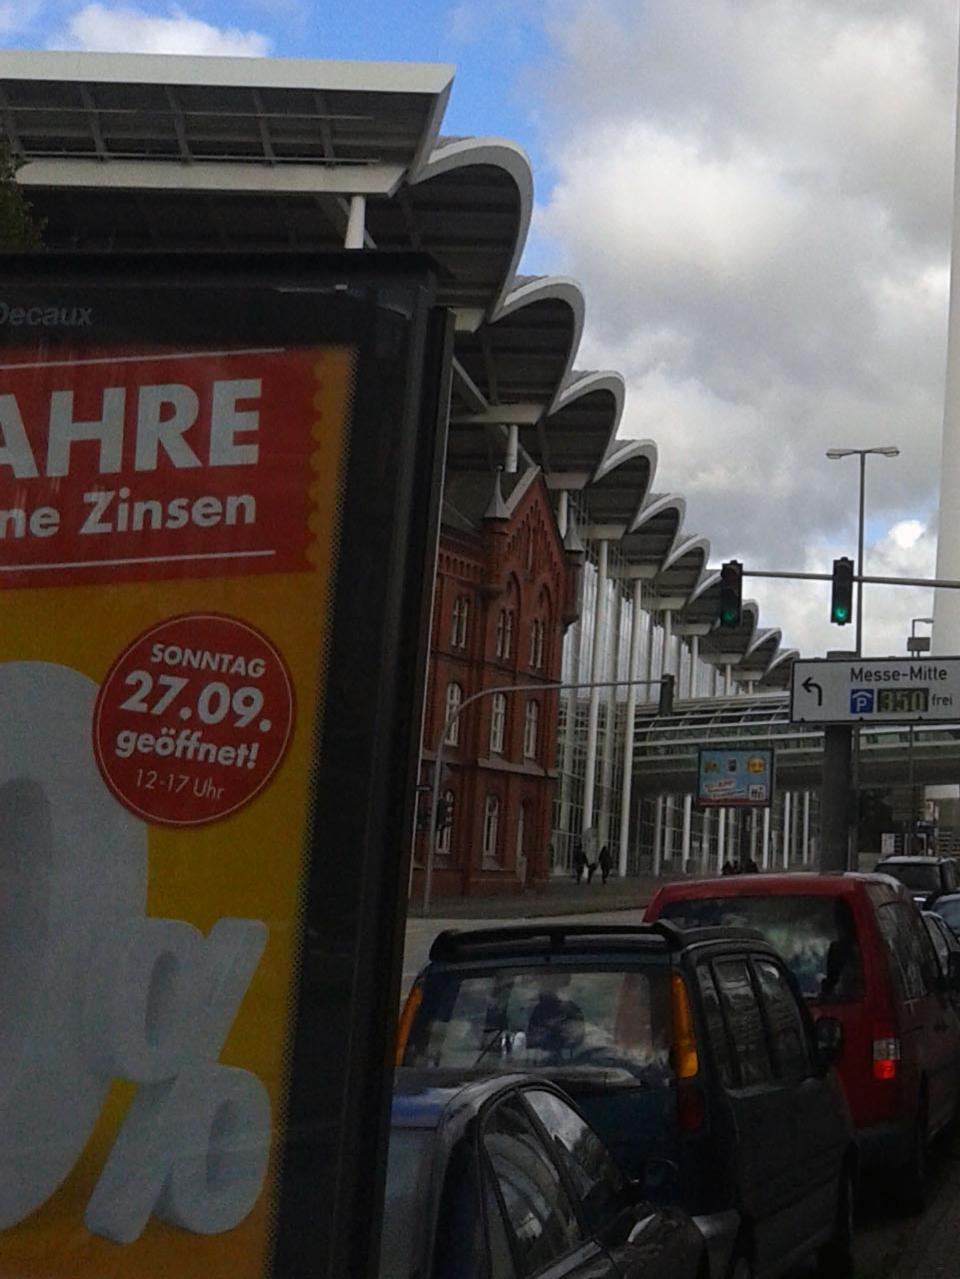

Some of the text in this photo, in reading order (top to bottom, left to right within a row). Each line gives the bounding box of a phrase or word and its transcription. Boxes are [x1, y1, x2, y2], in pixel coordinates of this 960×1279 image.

[79, 487, 257, 535] Zinsen
[149, 642, 266, 678] SONNTAG
[850, 665, 948, 683] Messe-Mitte
[119, 669, 272, 733] 27.09.
[931, 693, 953, 706] frei
[115, 726, 260, 770] geöffnet!
[136, 768, 225, 801] 12-17 Uhr
